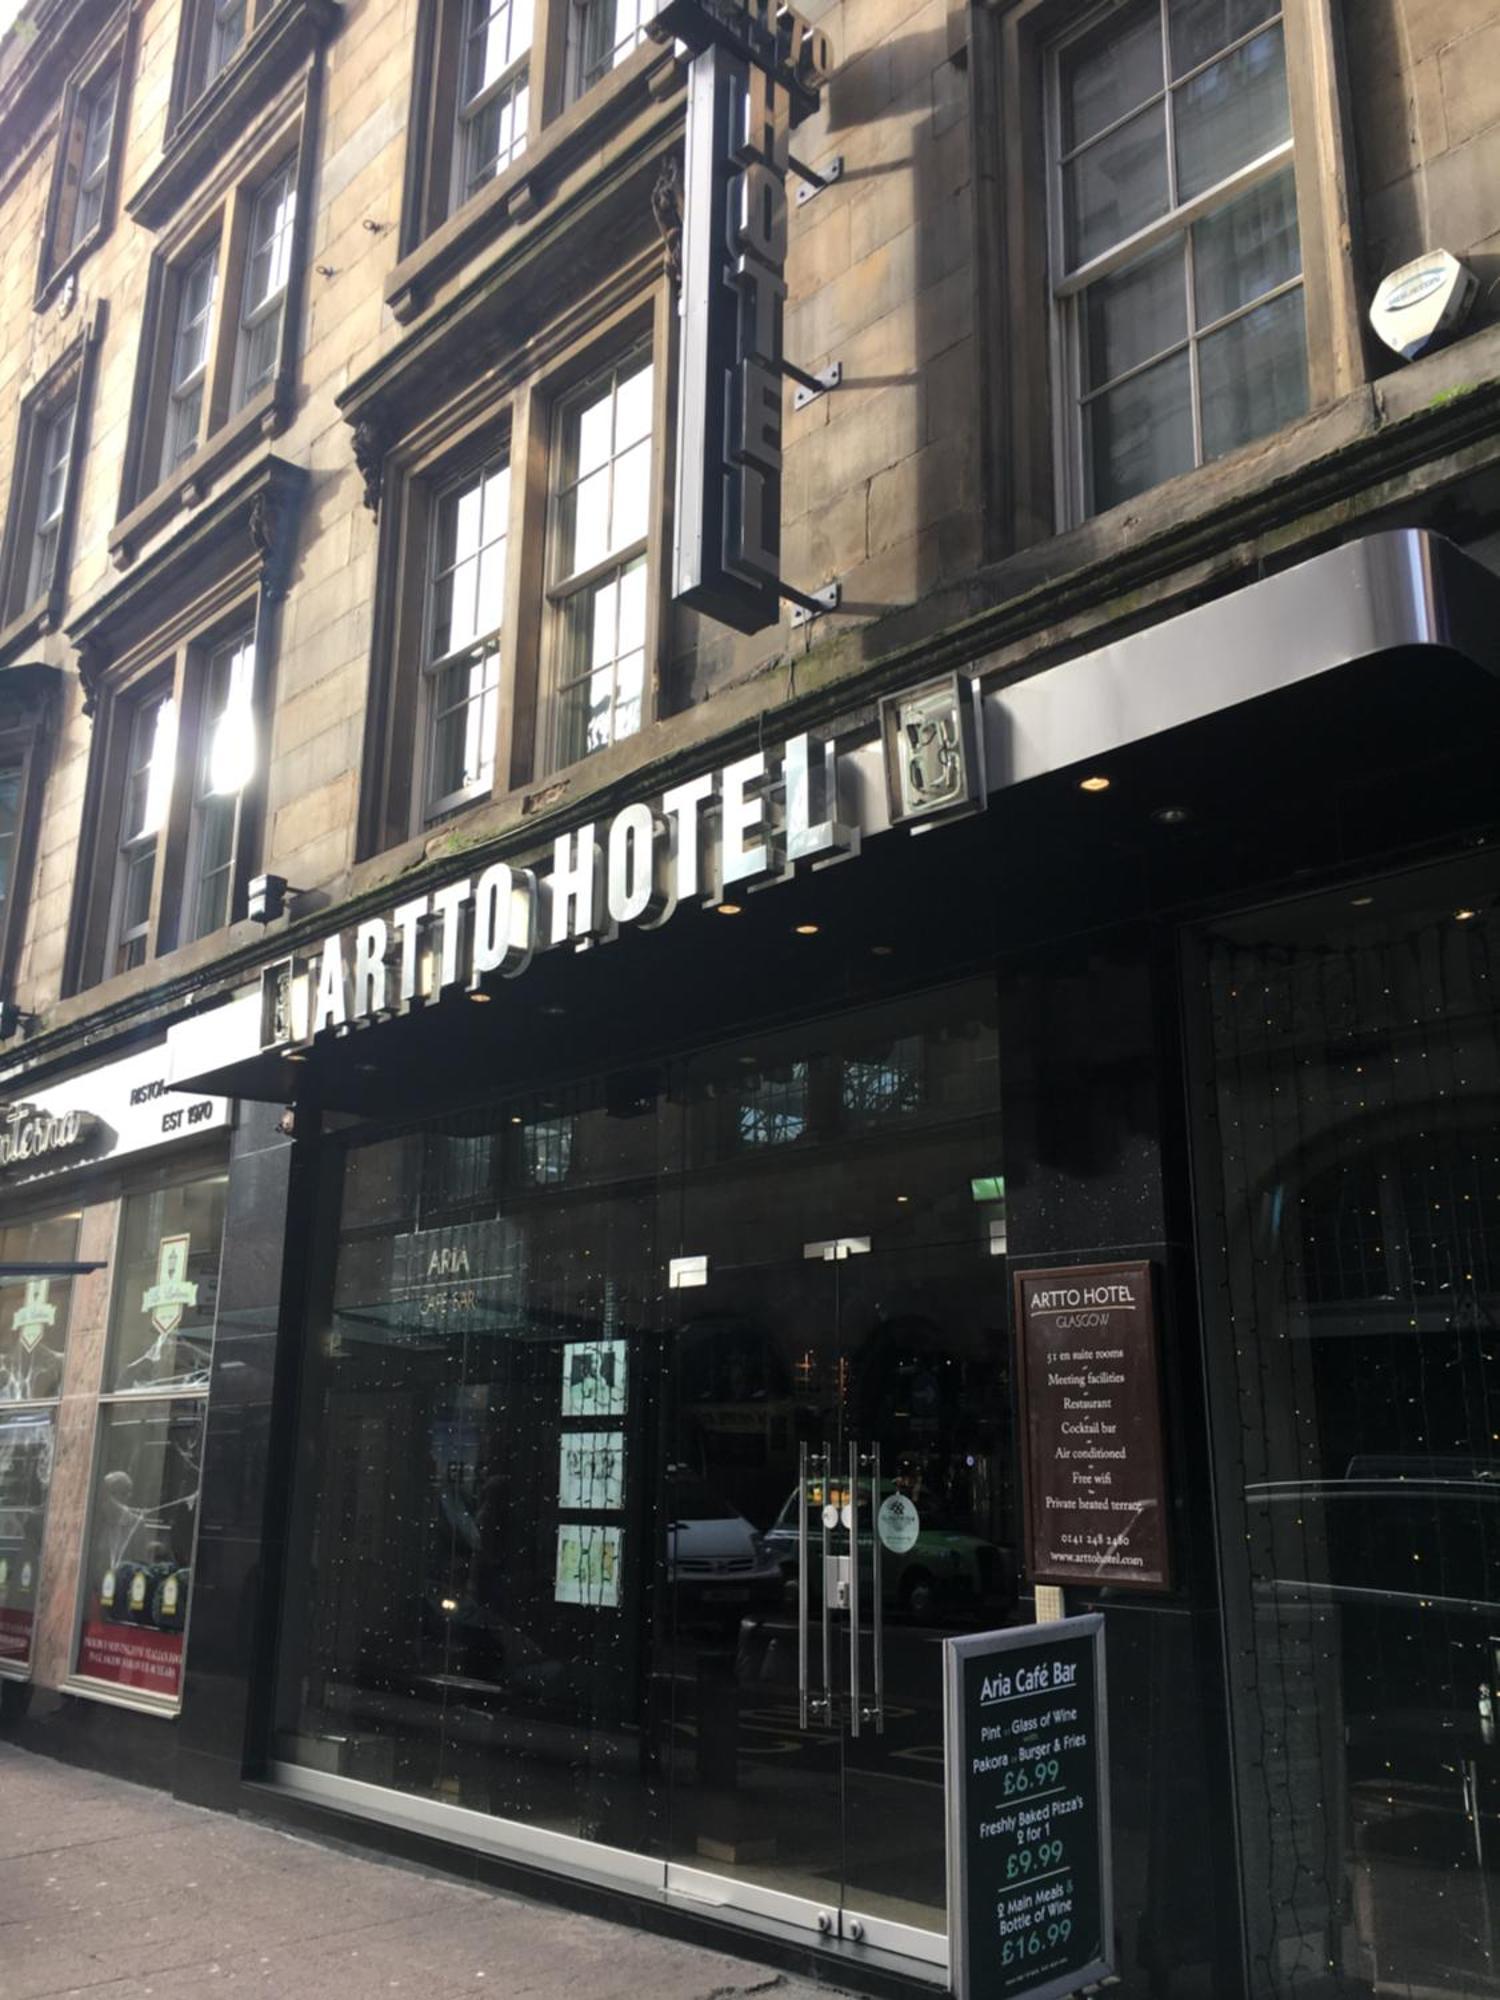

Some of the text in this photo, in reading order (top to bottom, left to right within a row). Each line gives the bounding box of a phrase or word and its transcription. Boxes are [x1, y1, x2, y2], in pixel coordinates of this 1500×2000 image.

[730, 60, 789, 583] HOTEL
[314, 732, 836, 1034] ARTTO HOTEL
[162, 1100, 213, 1132] EST 1970
[427, 1247, 470, 1276] ARIA
[1030, 1285, 1135, 1309] ARTTO HOTEL
[1056, 1313, 1109, 1328] GLASGOW
[1059, 1351, 1071, 1360] en
[1072, 1348, 1094, 1360] suite
[1095, 1349, 1124, 1359] rooms
[1048, 1371, 1125, 1388] Meeting facilities
[1063, 1397, 1112, 1409] Restaurant
[1061, 1421, 1116, 1434] Cocktail bar
[1055, 1446, 1126, 1459] Air conditioned
[1072, 1471, 1092, 1484] Free
[1045, 1496, 1077, 1509] Private
[1078, 1497, 1109, 1510] heated
[1050, 1551, 1143, 1567] www.arttohotel.com
[980, 1661, 1077, 1701] Aria Café Bar
[980, 1725, 1001, 1742] Pint
[1011, 1717, 1039, 1735] Glass
[1040, 1709, 1051, 1727] of
[1052, 1708, 1078, 1723] Wine
[972, 1754, 1009, 1775] Pakora
[1018, 1742, 1051, 1761] Burger
[1062, 1733, 1087, 1750] Fries
[1003, 1759, 1060, 1796] £6.99
[979, 1816, 1017, 1840] Freshly
[1018, 1804, 1051, 1827] Baked
[1026, 1826, 1042, 1843] for
[1006, 1840, 1064, 1879] £9.99
[1006, 1895, 1033, 1915] Main
[1035, 1883, 1065, 1905] Meals
[999, 1899, 1073, 1937] Bottle of Wine
[1001, 1919, 1072, 1966] £16.99
